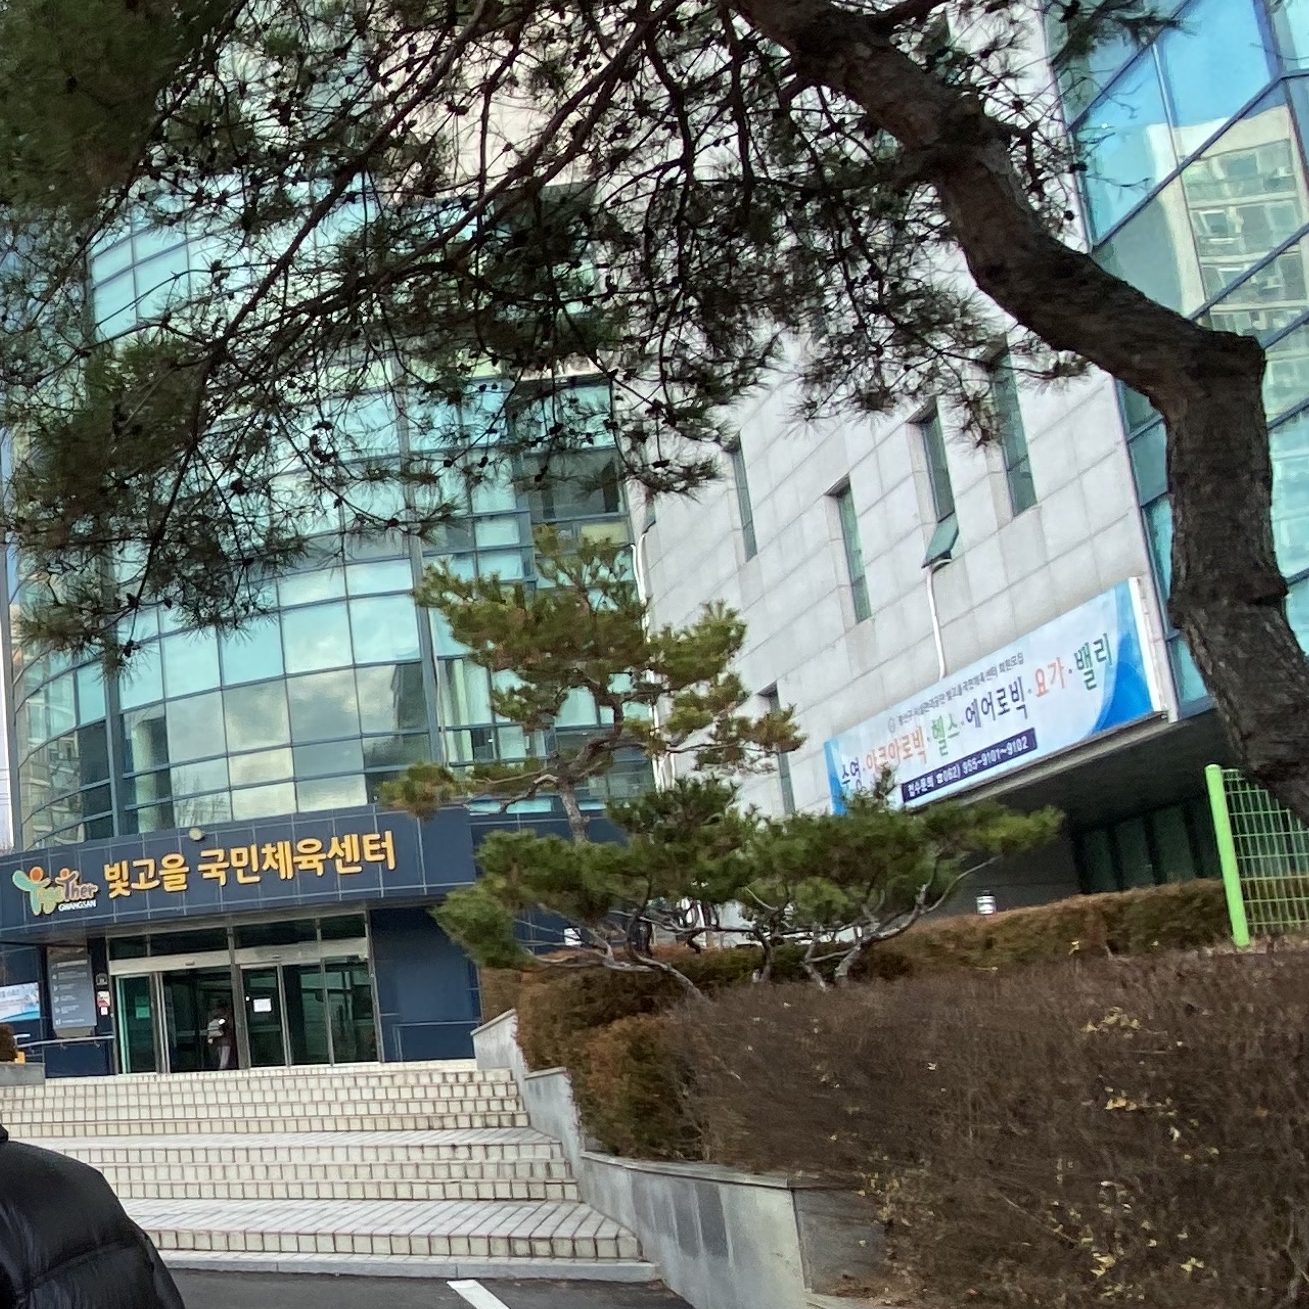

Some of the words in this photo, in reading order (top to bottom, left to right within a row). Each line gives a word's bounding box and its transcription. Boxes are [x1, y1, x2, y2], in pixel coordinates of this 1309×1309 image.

[931, 713, 960, 756] 헬스
[965, 675, 1028, 728] 에어로빅
[1035, 656, 1066, 698] 요가
[1074, 632, 1113, 691] 밸리
[103, 852, 190, 899] 빛고을
[197, 830, 396, 887] 국민체육센터
